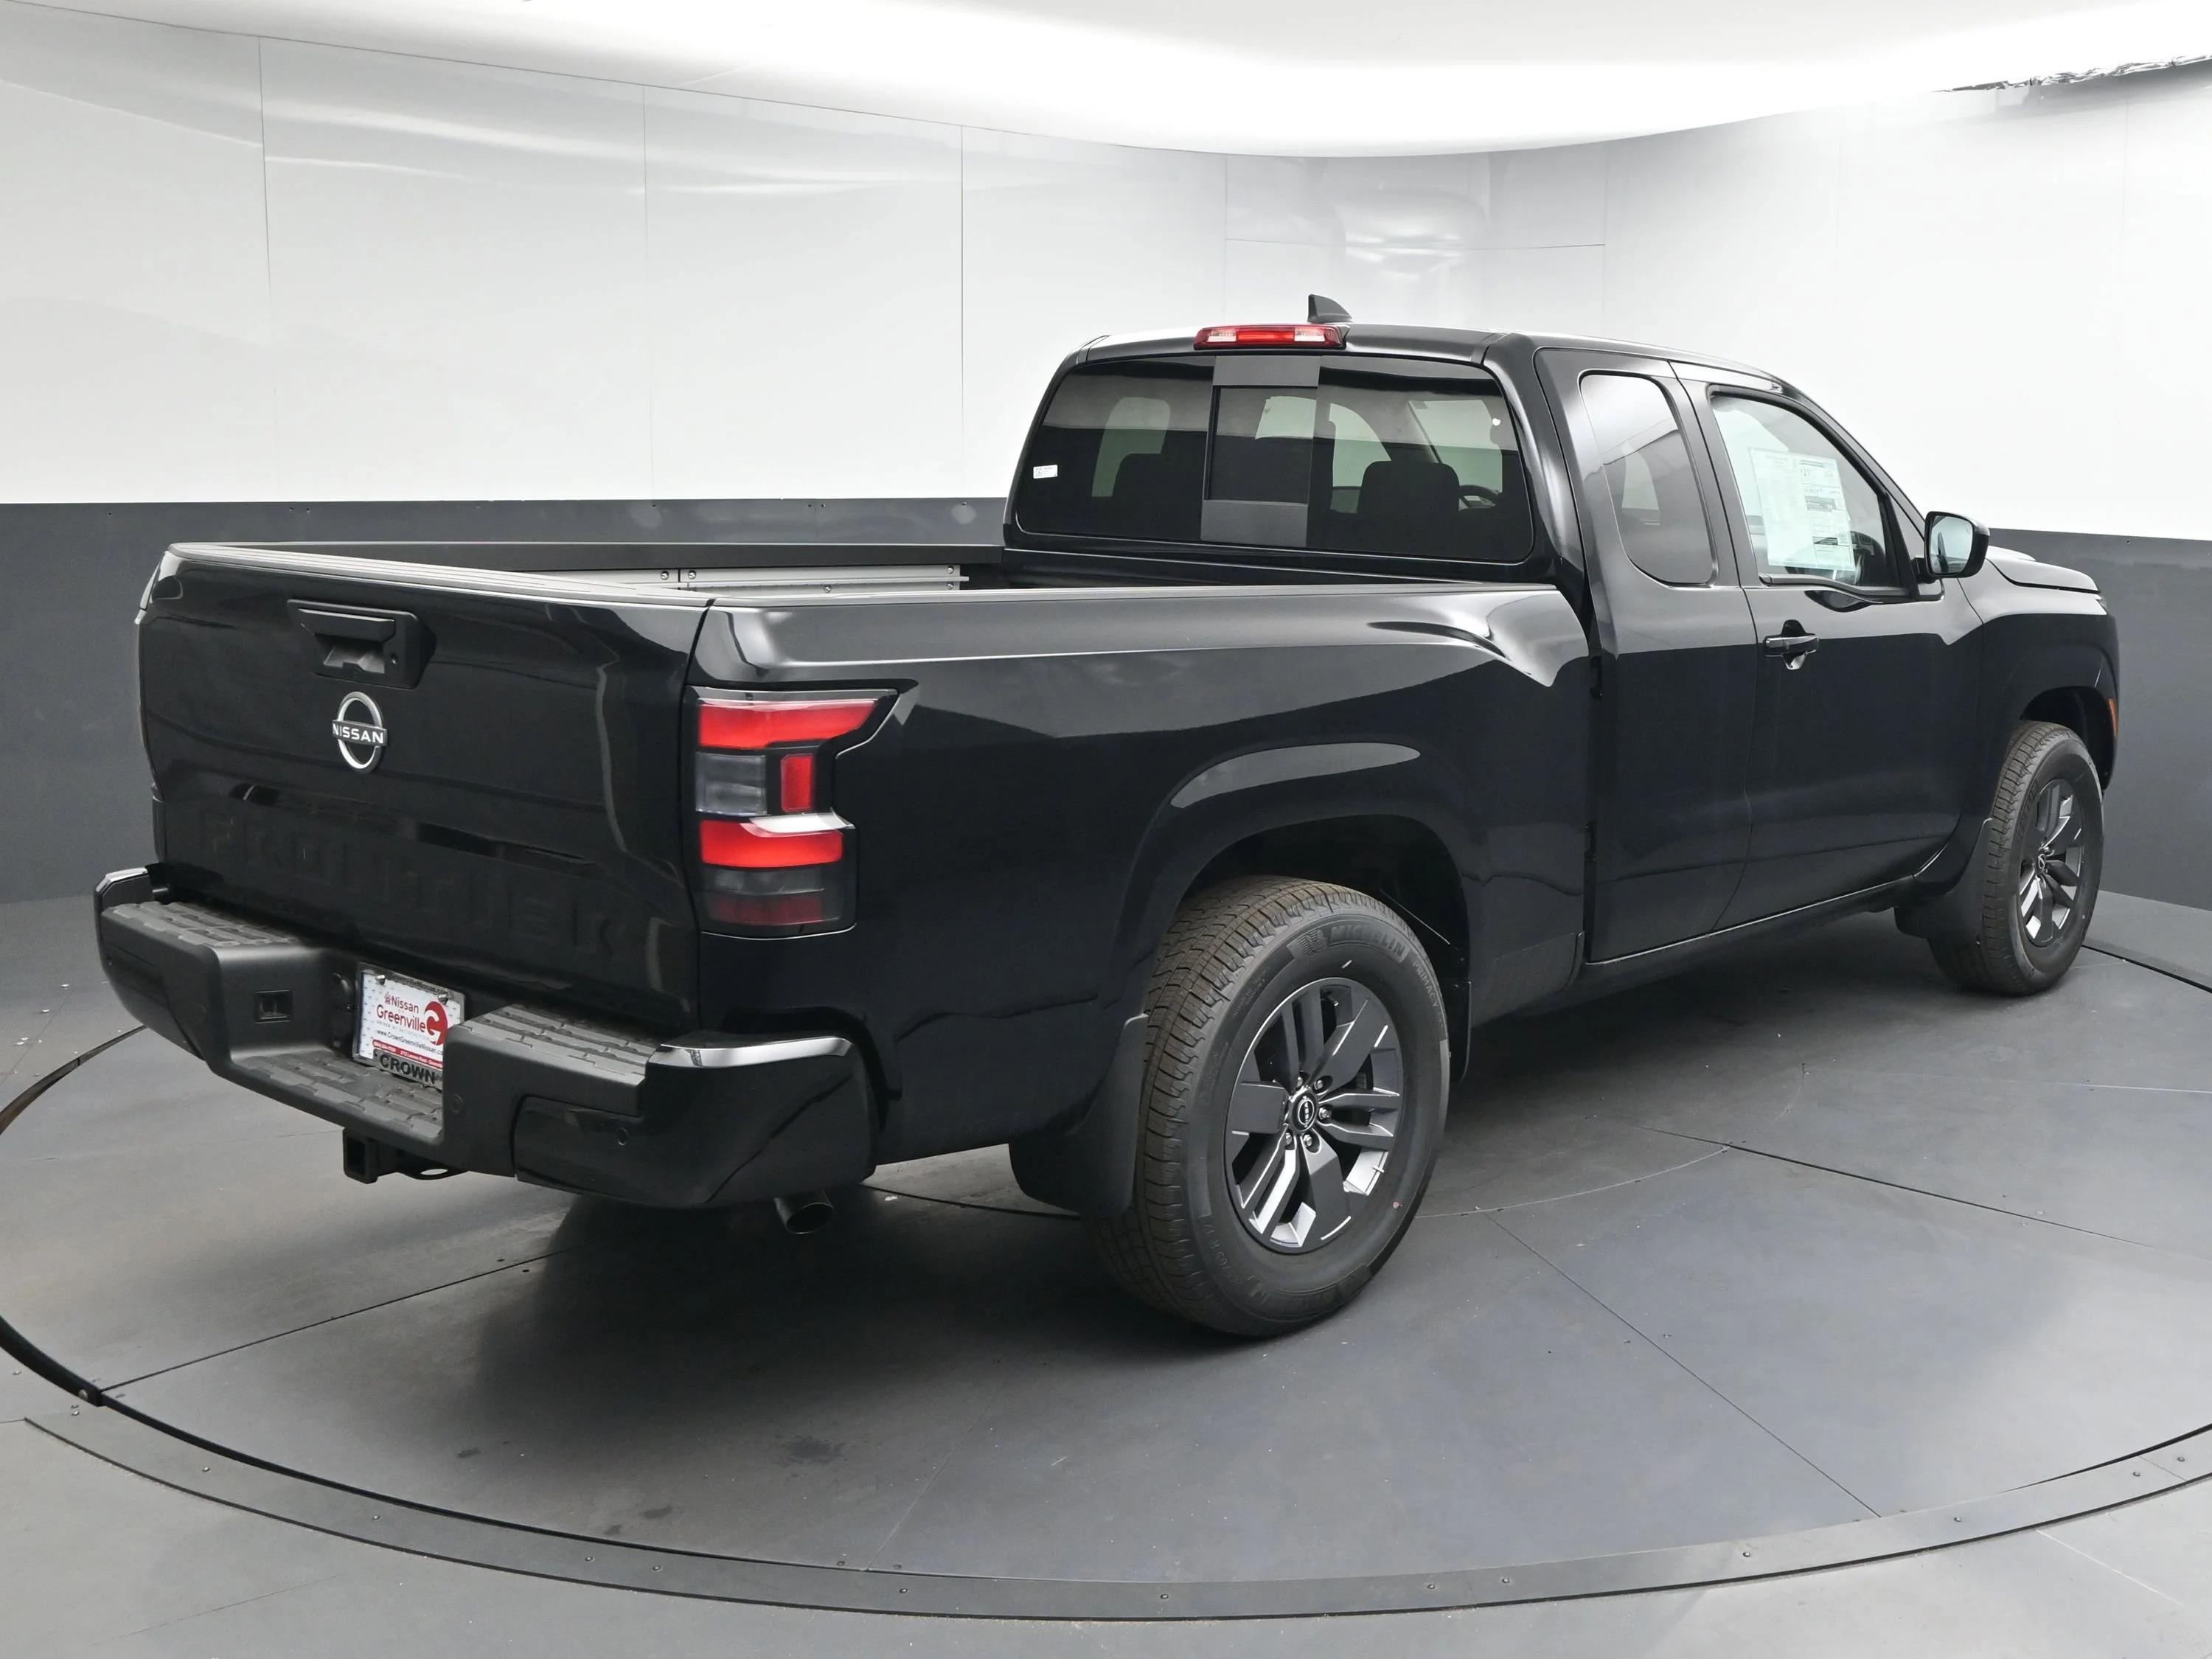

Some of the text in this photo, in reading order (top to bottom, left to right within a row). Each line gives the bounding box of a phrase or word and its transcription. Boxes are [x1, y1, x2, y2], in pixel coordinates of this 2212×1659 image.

[333, 723, 383, 744] NISSAN
[1330, 924, 1405, 957] MICHELIN
[377, 1004, 425, 1032] Greenville
[391, 995, 420, 1014] Nissan
[377, 1029, 442, 1056] www.CrownGreenvilleNissan.co
[380, 1054, 436, 1084] CROWN
